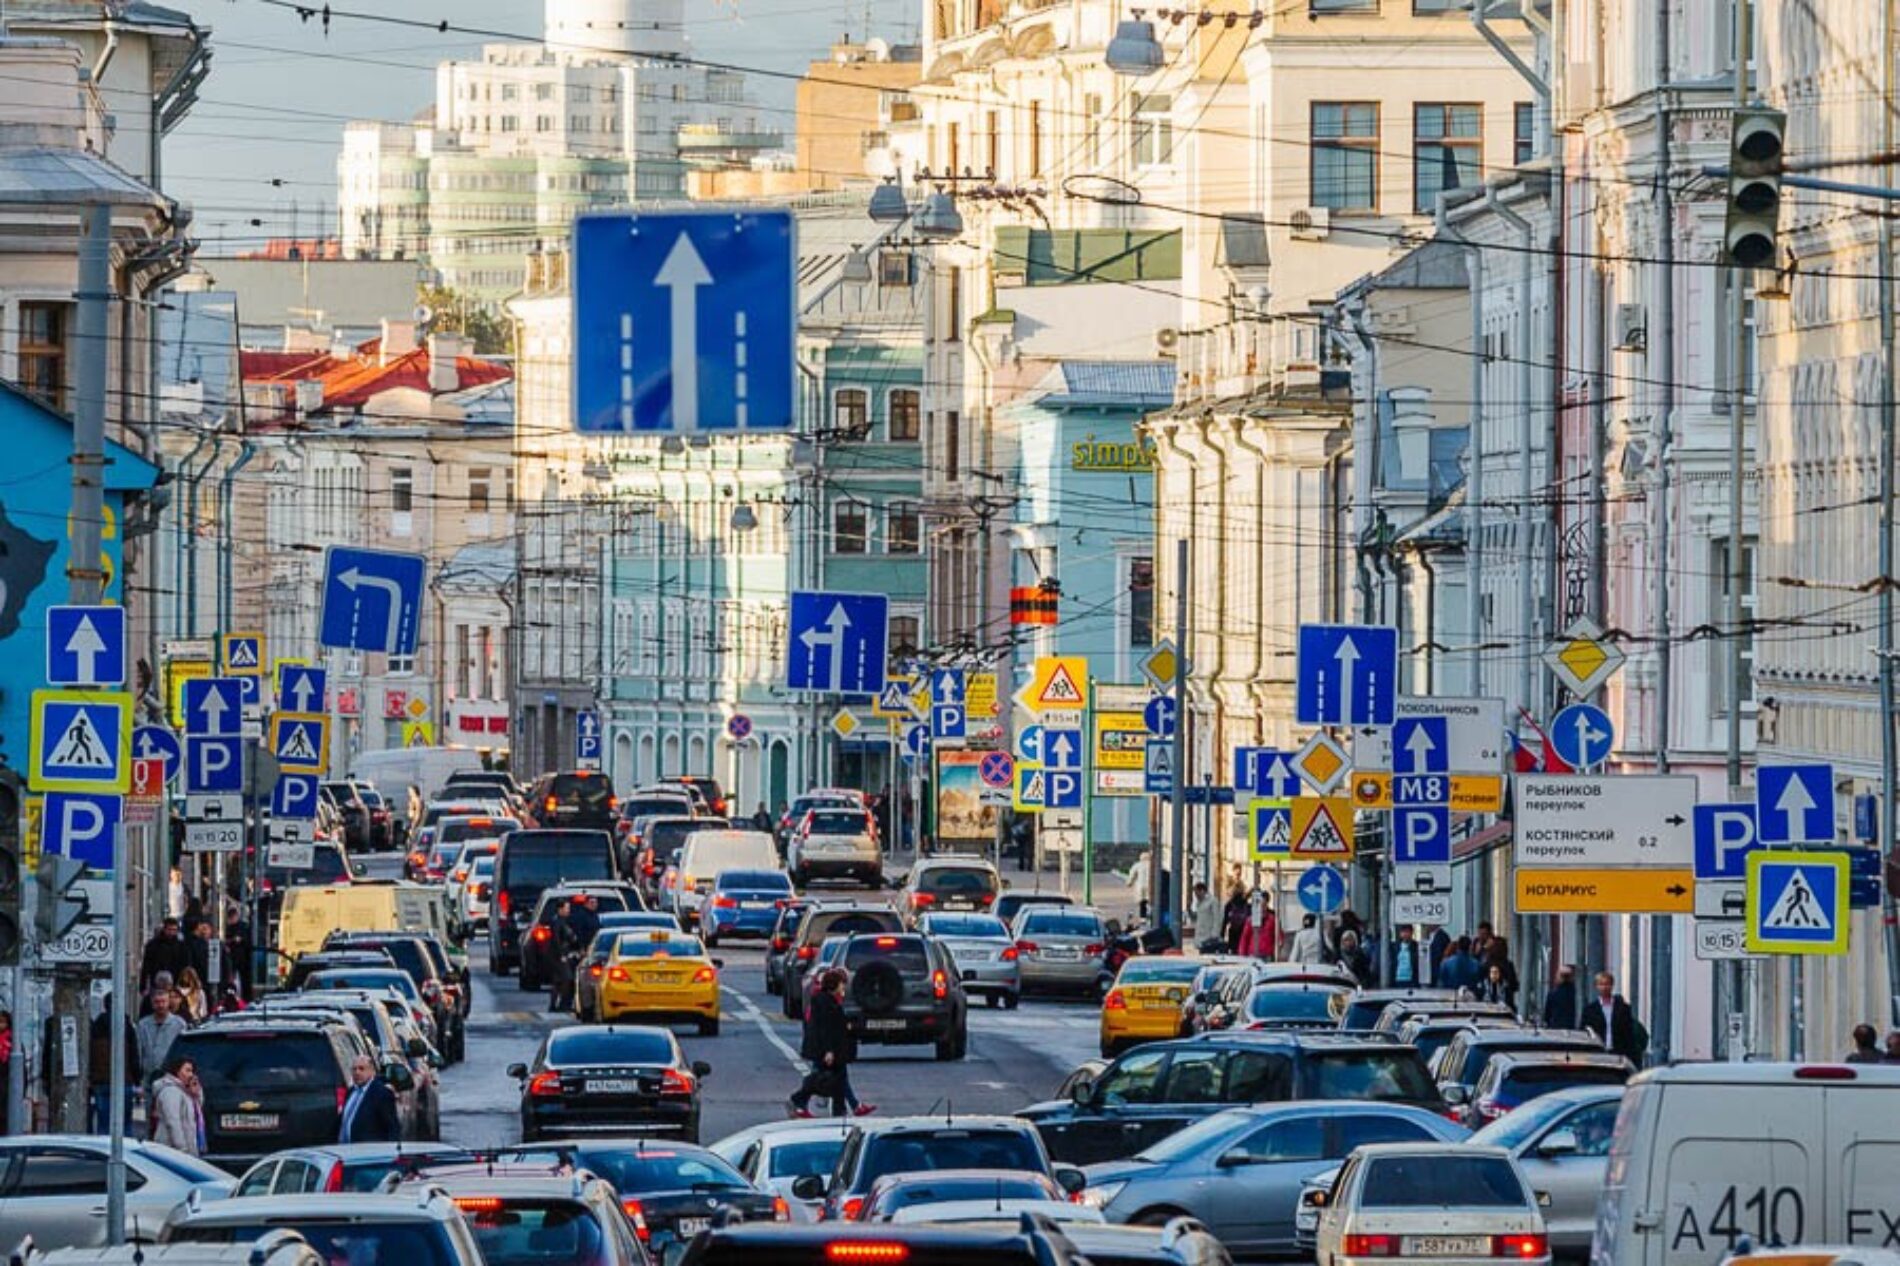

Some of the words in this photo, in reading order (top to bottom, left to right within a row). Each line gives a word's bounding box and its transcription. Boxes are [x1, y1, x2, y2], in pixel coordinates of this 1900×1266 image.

[1397, 703, 1479, 715] ЛОКОЛЬНИКОВ
[941, 708, 960, 735] P
[582, 738, 596, 756] P
[200, 742, 231, 786] P
[282, 777, 309, 813] P
[1052, 774, 1076, 805] P
[1400, 777, 1442, 801] М8
[1525, 784, 1602, 796] РЫБНИКОВ
[1525, 800, 1586, 812] переулок
[61, 800, 104, 860] P
[219, 831, 237, 843] 20
[1406, 811, 1438, 857] P
[1525, 828, 1615, 841] КОСТЯНСКИЙ
[1638, 836, 1658, 848] 0.2
[1714, 811, 1755, 871] P
[1525, 846, 1586, 857] переулок
[1525, 885, 1597, 896] НОТАРИУС
[1427, 903, 1444, 916] 20
[66, 937, 81, 951] 15
[86, 935, 109, 951] 20
[1705, 935, 1717, 946] 10
[1721, 934, 1734, 947] 15
[1671, 1184, 1804, 1251] А410
